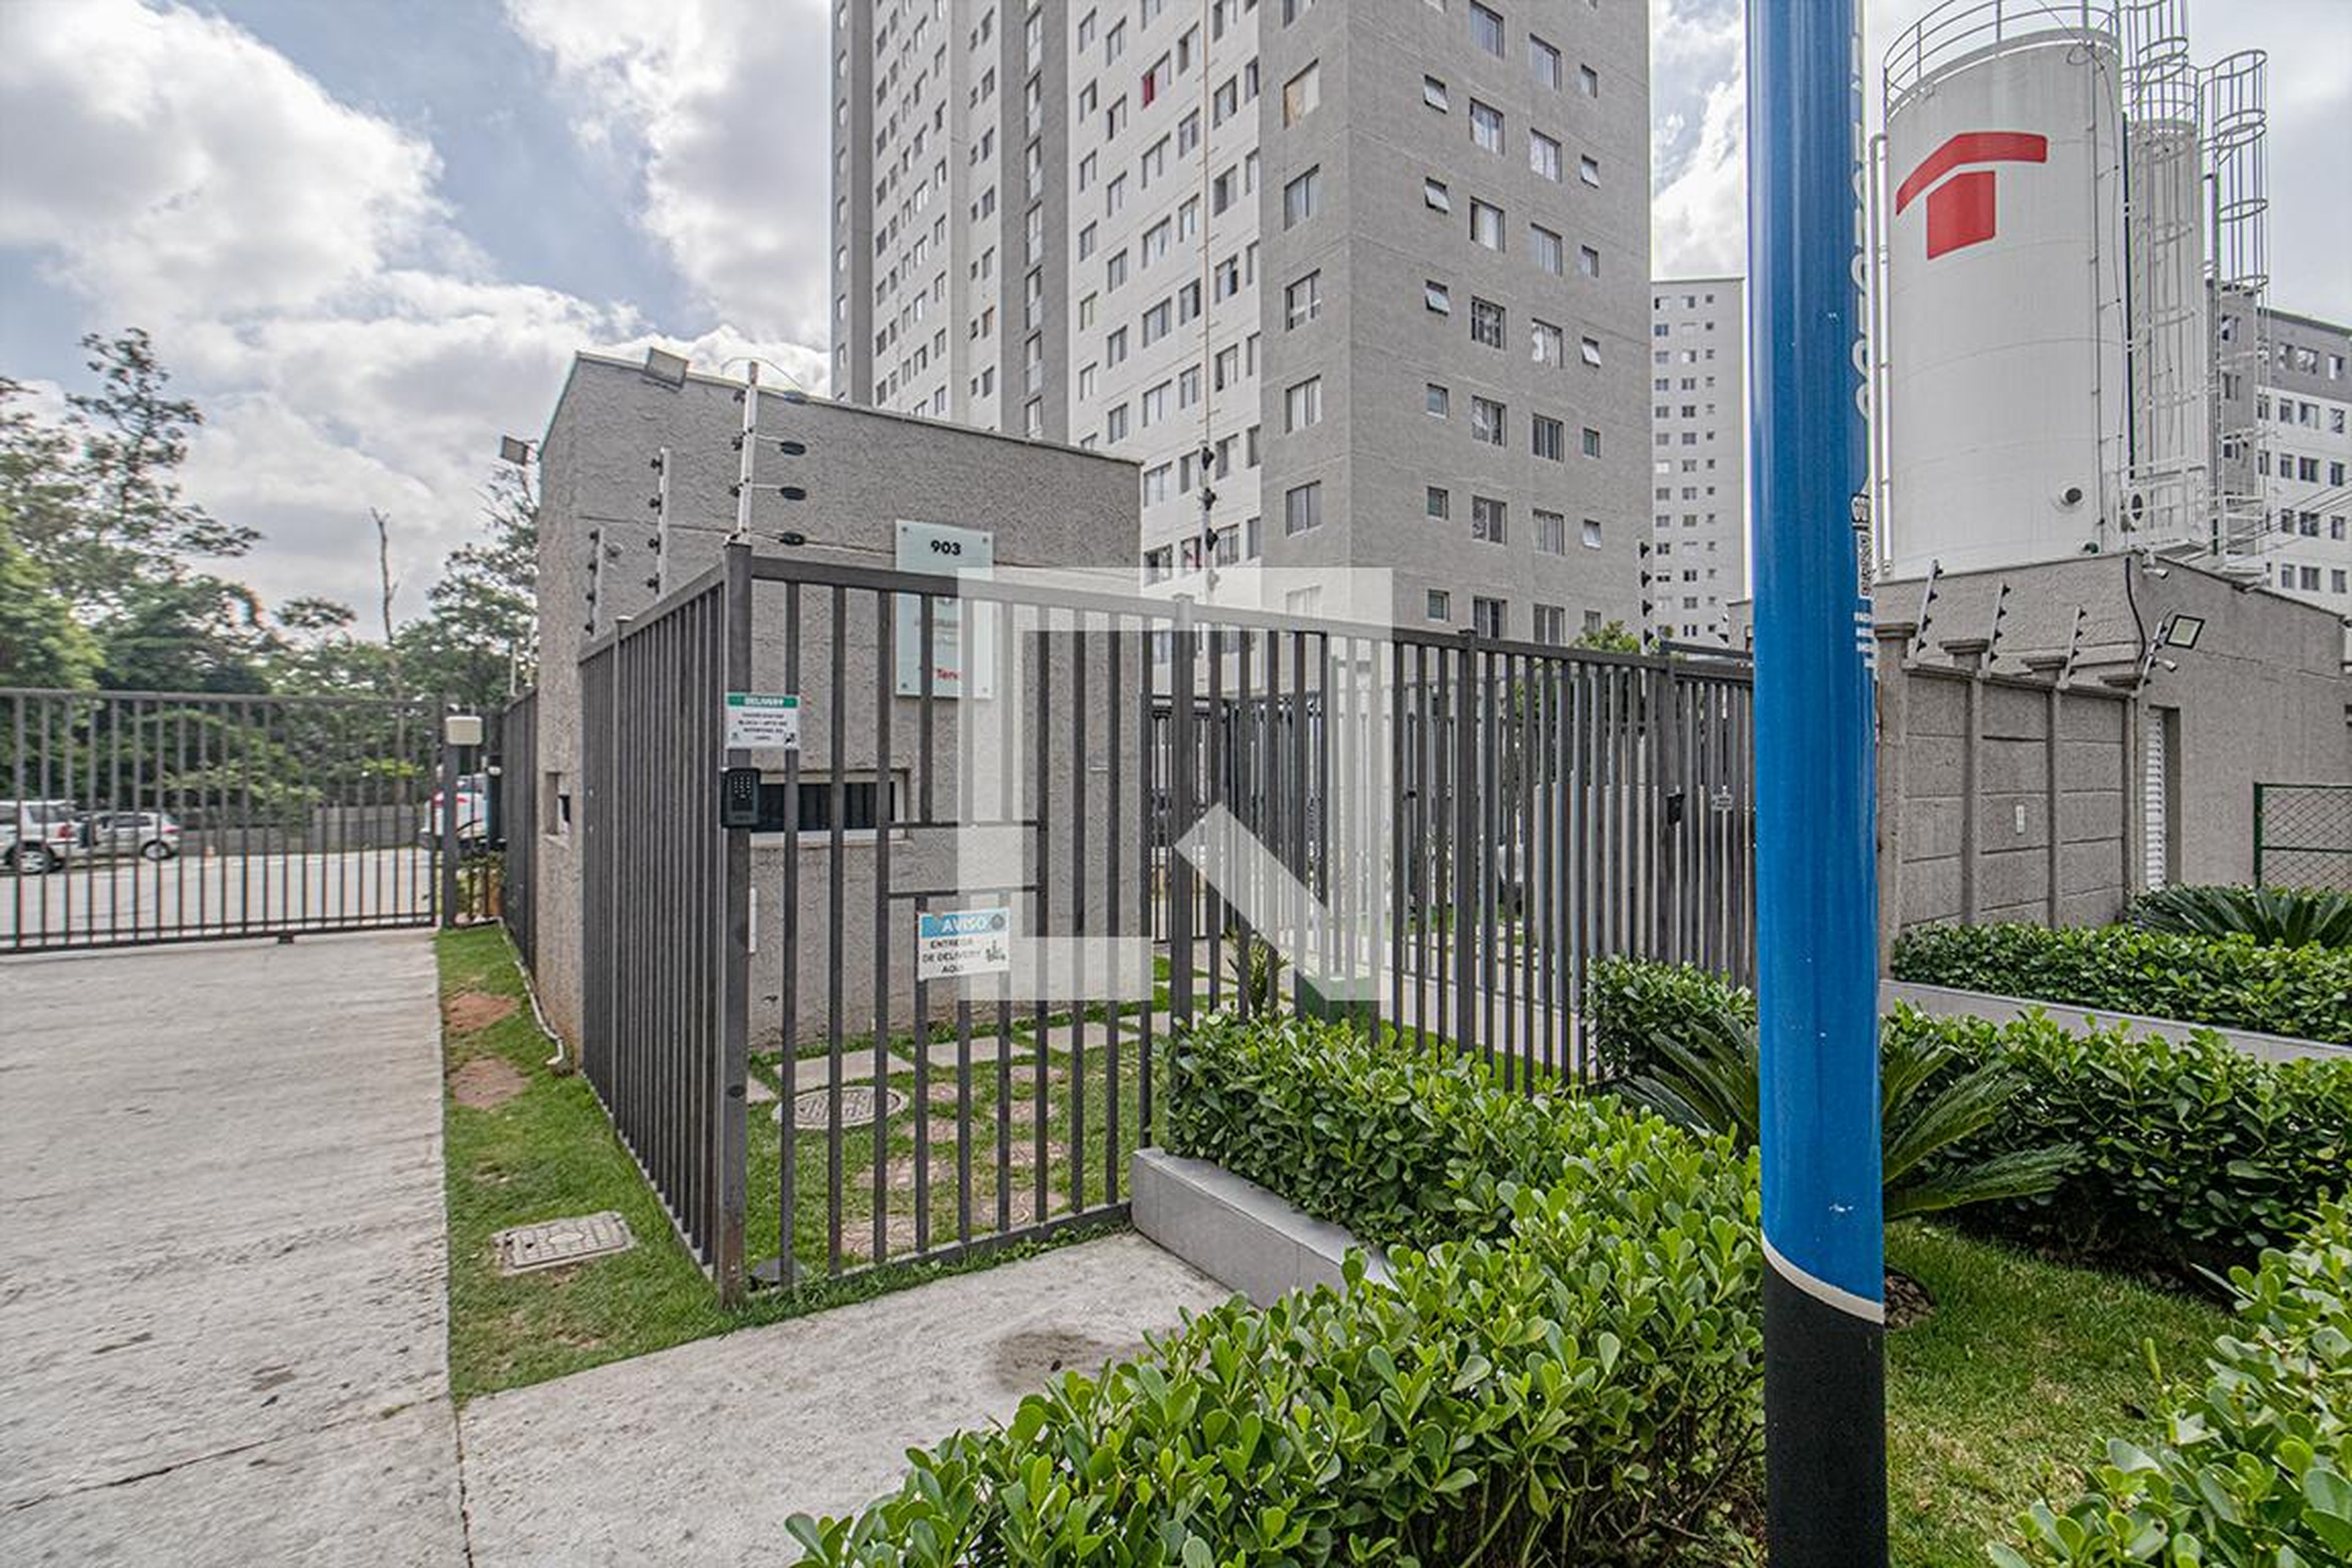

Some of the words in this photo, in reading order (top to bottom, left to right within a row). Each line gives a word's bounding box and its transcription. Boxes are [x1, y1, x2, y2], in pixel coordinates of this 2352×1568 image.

[930, 540, 961, 556] 903
[744, 697, 784, 706] DELIVERY
[941, 916, 987, 933] AVISO
[922, 954, 935, 963] DE
